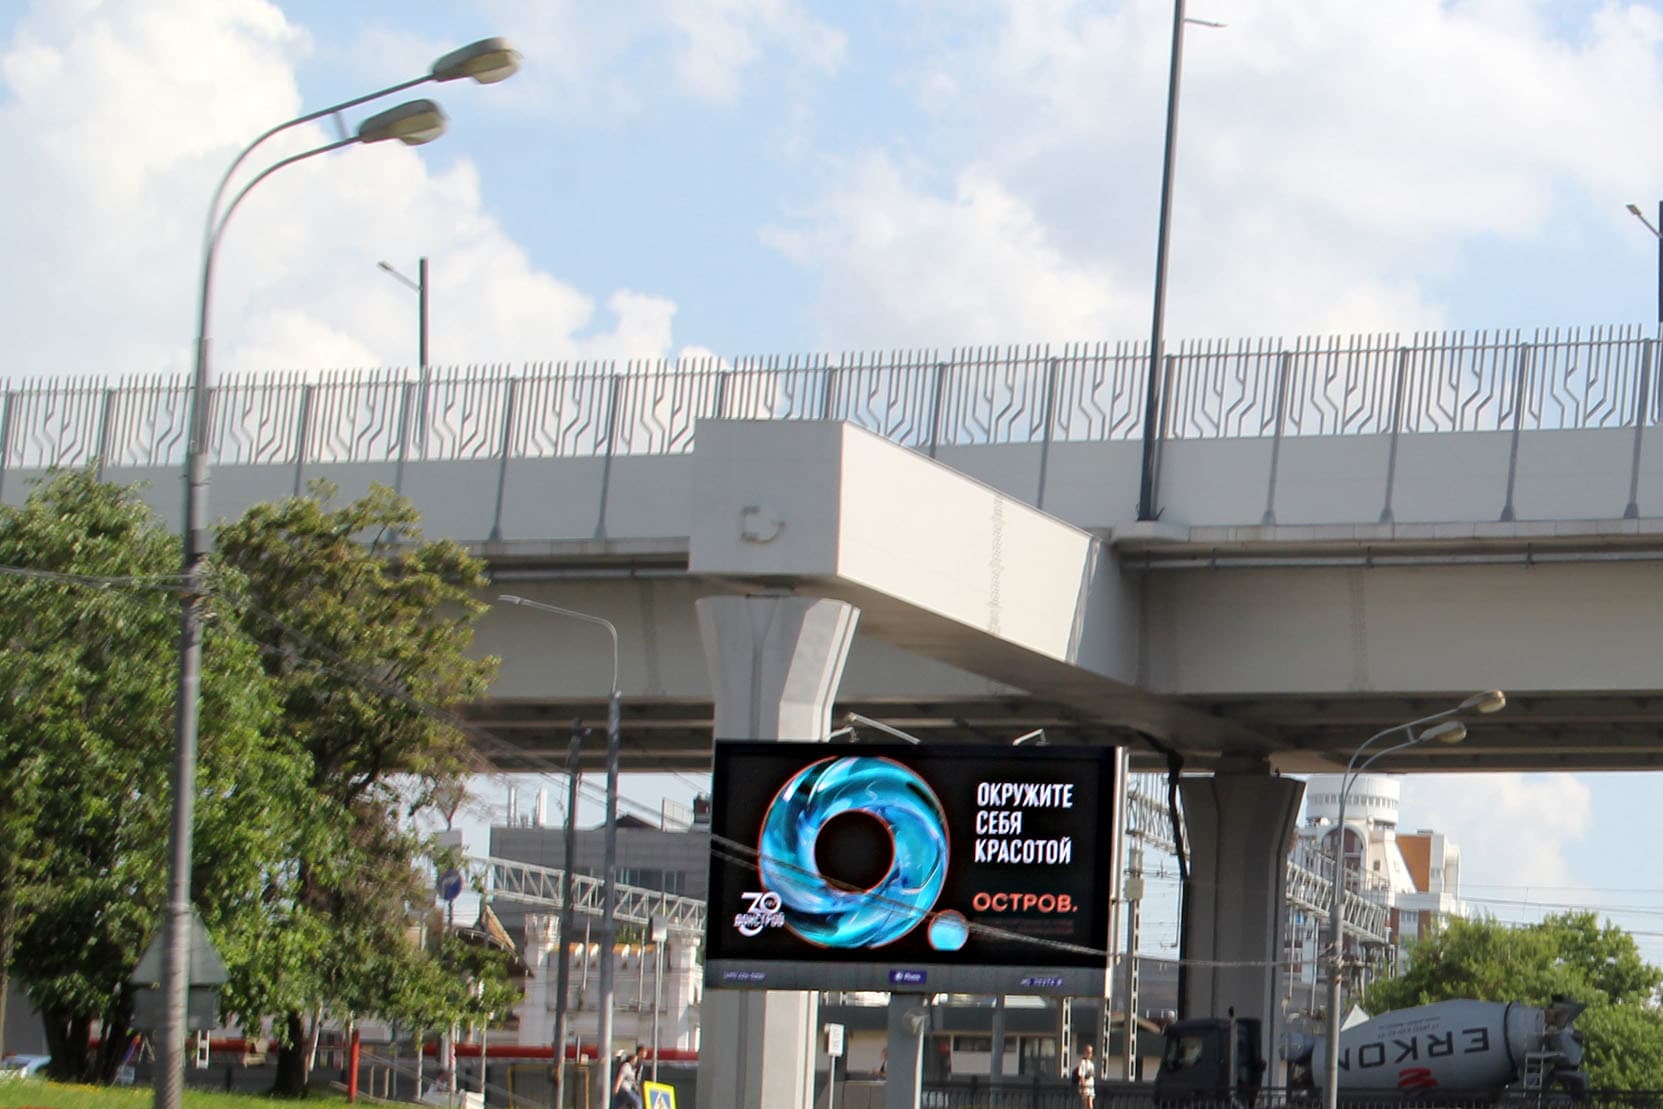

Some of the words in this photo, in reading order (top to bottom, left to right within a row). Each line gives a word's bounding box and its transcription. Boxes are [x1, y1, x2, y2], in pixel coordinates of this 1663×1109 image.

[977, 782, 1074, 808] ОКРУЖИТЕ
[975, 810, 1023, 835] СЕБЯ
[974, 836, 1072, 865] КРАСОТОЙ
[972, 892, 1078, 913] ОСТРОВ.
